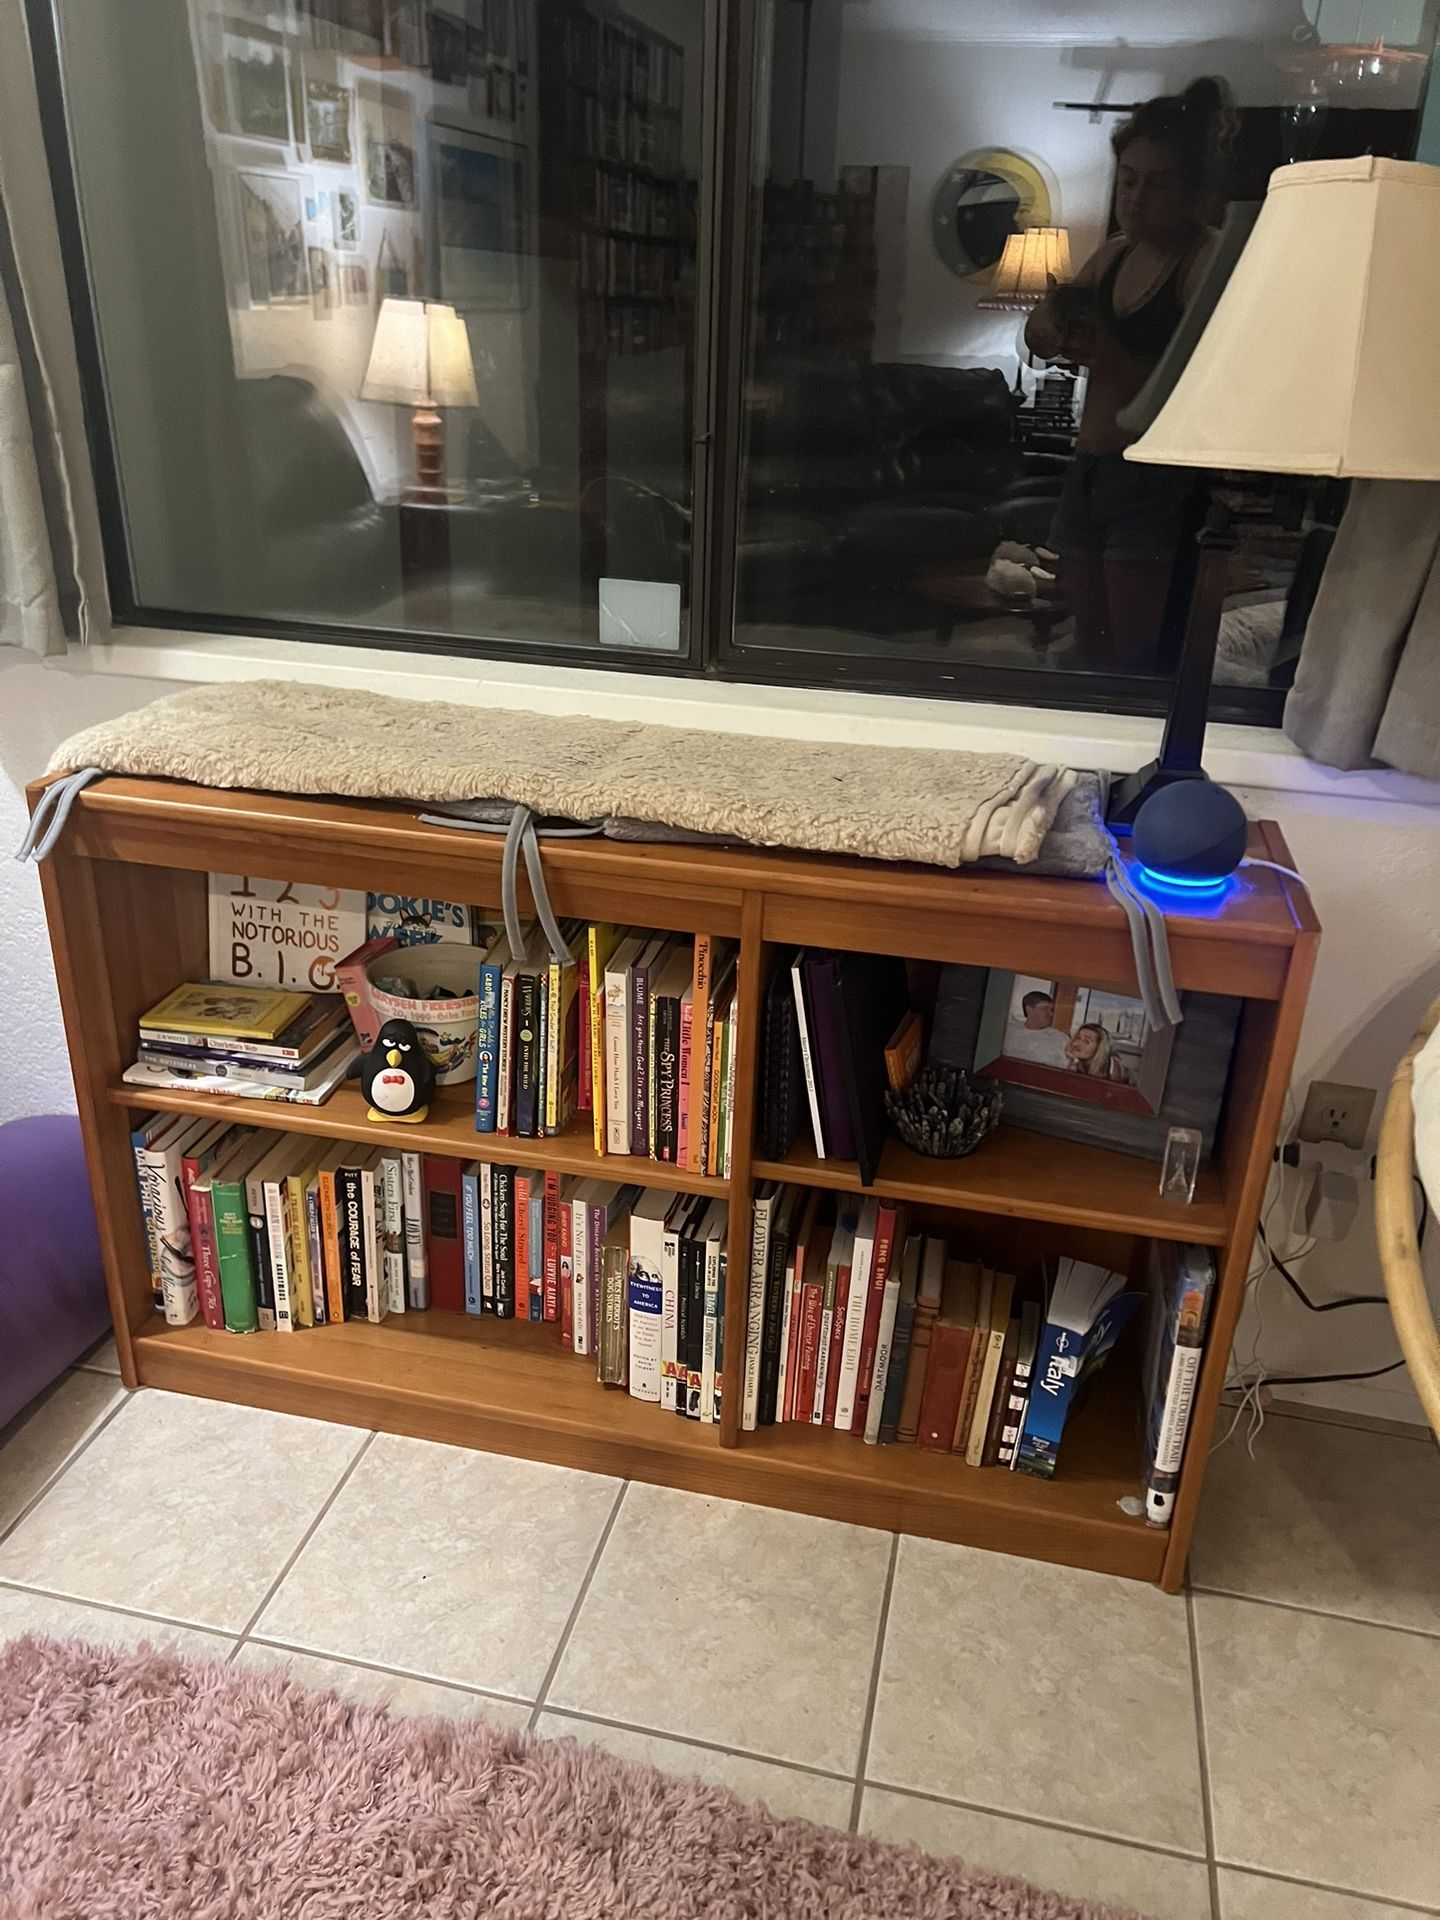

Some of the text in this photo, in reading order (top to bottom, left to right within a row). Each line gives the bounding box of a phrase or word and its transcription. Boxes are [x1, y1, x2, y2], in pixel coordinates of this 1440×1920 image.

[231, 902, 339, 930] WITH THE
[232, 921, 340, 953] NOTORIOUS
[697, 941, 709, 990] Pinocchio
[485, 973, 493, 994] CABOT
[635, 977, 644, 1005] BLUME
[636, 1014, 645, 1025] Are
[479, 1028, 487, 1048] GIRLS
[635, 1026, 643, 1038] you
[681, 1020, 692, 1045] Little
[210, 1039, 243, 1050] Charlotte's
[637, 1039, 645, 1055] there
[636, 1056, 645, 1076] God?
[660, 1051, 675, 1078] SPY
[681, 1047, 691, 1079] Women
[712, 1069, 720, 1104] GOODNIGHT
[634, 1100, 645, 1131] Margaret
[659, 1079, 675, 1132] PRINCESS
[135, 1146, 155, 1233] DAN PHIL GO
[147, 1164, 167, 1231] Voracious
[386, 1165, 399, 1222] Sisters First
[465, 1184, 473, 1193] IF
[499, 1174, 508, 1201] Chicken
[466, 1193, 474, 1207] YOU
[498, 1202, 508, 1219] Soup
[547, 1193, 556, 1225] JUDGING
[466, 1207, 474, 1224] FEEL
[499, 1220, 508, 1231] For
[516, 1203, 527, 1226] Cheryl
[576, 1213, 584, 1226] It's
[346, 1182, 361, 1286] the COURAGE of FEAR
[466, 1226, 474, 1240] TOO
[484, 1222, 490, 1230] So
[547, 1228, 556, 1243] YOU
[752, 1207, 768, 1266] FLOWER
[499, 1233, 508, 1245] The
[517, 1233, 527, 1264] Strayed
[575, 1230, 584, 1246] Not
[202, 1246, 211, 1268] Three
[466, 1240, 474, 1261] MUCH
[499, 1246, 508, 1261] Soul
[575, 1250, 584, 1266] Fair
[484, 1253, 492, 1274] Status
[546, 1258, 556, 1285] LUVVIE
[874, 1239, 889, 1290] FENG SHUI
[203, 1270, 216, 1288] Cups
[484, 1275, 493, 1290] Quo
[594, 1273, 600, 1281] Us
[614, 1270, 622, 1293] JAMES
[630, 1281, 662, 1292] EYEWITNESS
[208, 1294, 217, 1309] Tea
[546, 1286, 556, 1308] AJAYI
[606, 1277, 614, 1323] DOG STORIES
[633, 1299, 658, 1309] AMERICA
[705, 1293, 716, 1314] TRAVEL
[851, 1295, 863, 1312] THE
[664, 1289, 675, 1329] CHINA
[747, 1268, 763, 1355] ARRANGING
[801, 1288, 818, 1370] The Way of Chinese Painting
[821, 1312, 830, 1346] apartment
[848, 1317, 861, 1344] HOME
[819, 1347, 827, 1379] GARDENING
[875, 1343, 888, 1392] DARTMOOR
[1040, 1355, 1066, 1396] Italy
[1169, 1356, 1198, 1464] OFF THE TOURIST TRAIL
